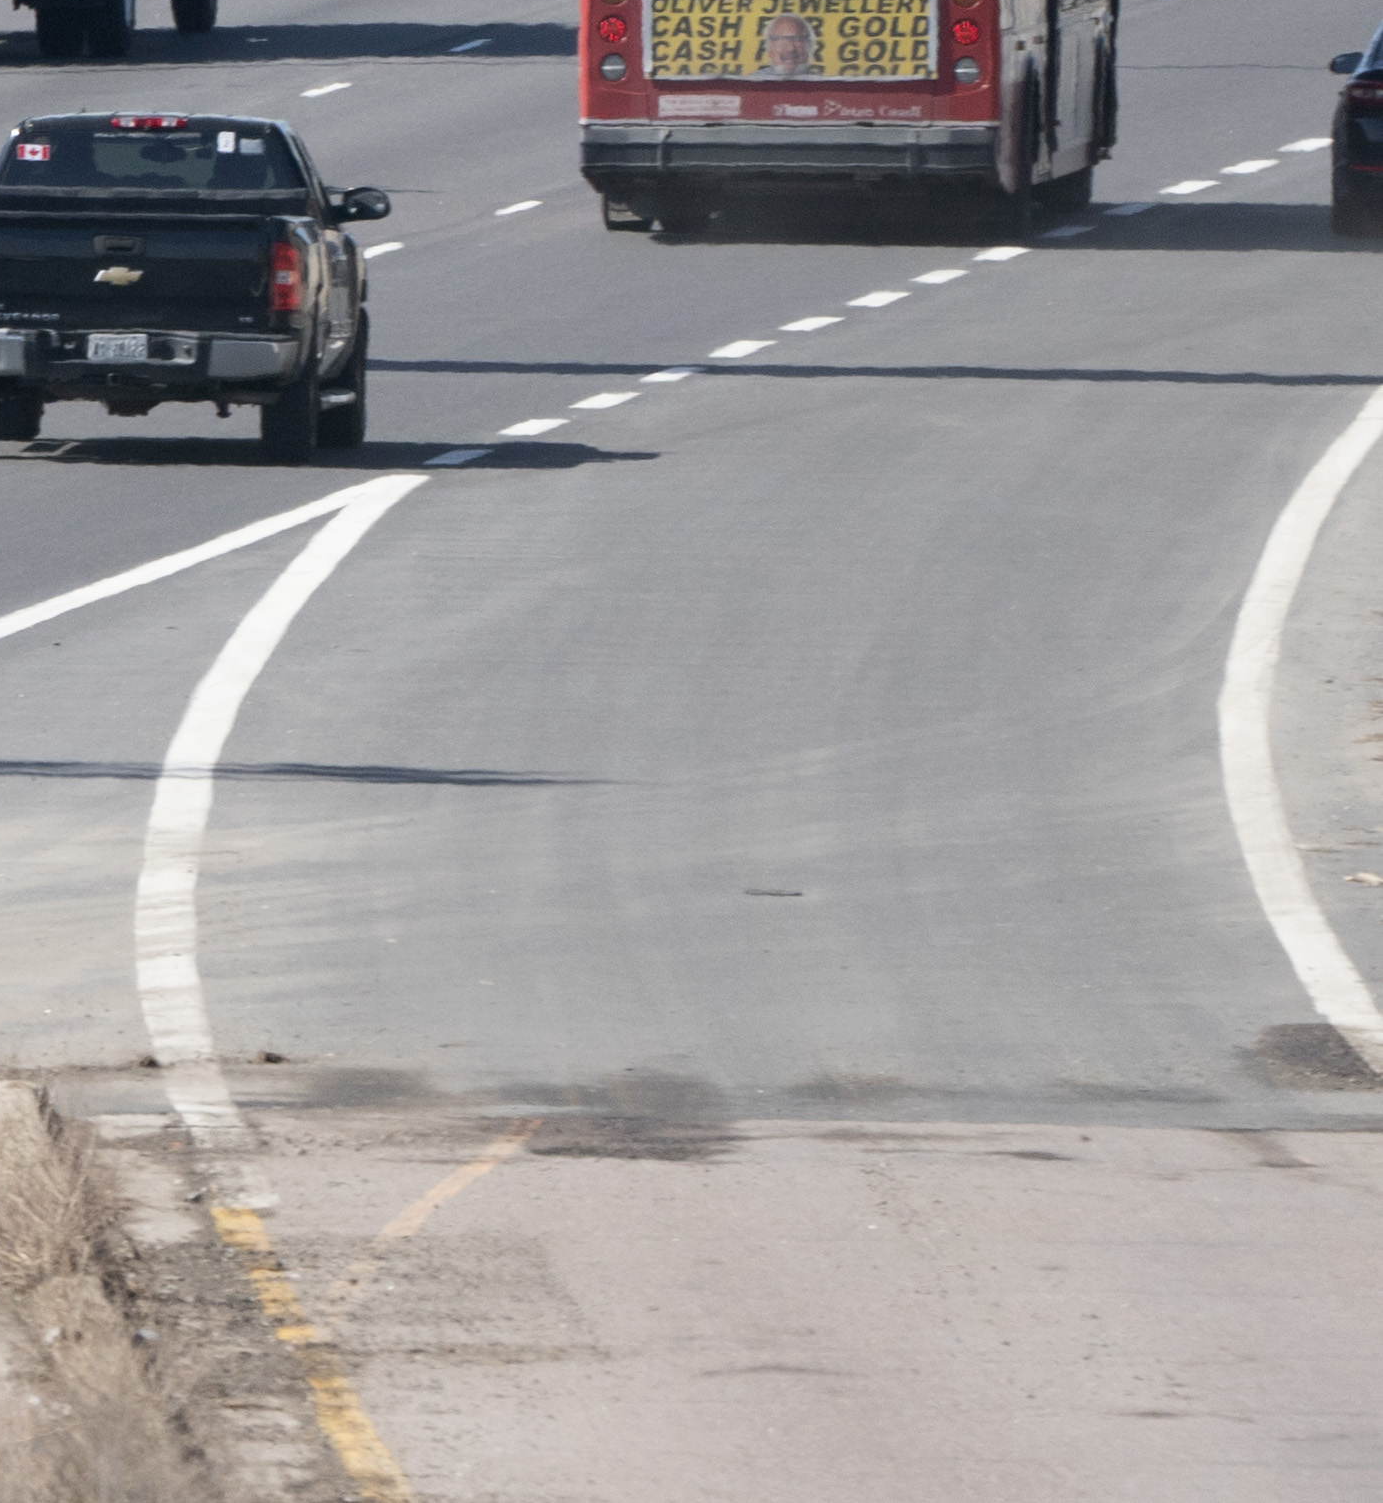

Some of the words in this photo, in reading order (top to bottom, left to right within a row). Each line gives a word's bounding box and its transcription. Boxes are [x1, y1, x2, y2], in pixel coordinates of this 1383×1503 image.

[652, 15, 742, 38] CASH
[756, 16, 825, 38] FR
[838, 15, 931, 38] GOLD
[652, 40, 742, 62] CASH
[837, 40, 931, 63] GOLD
